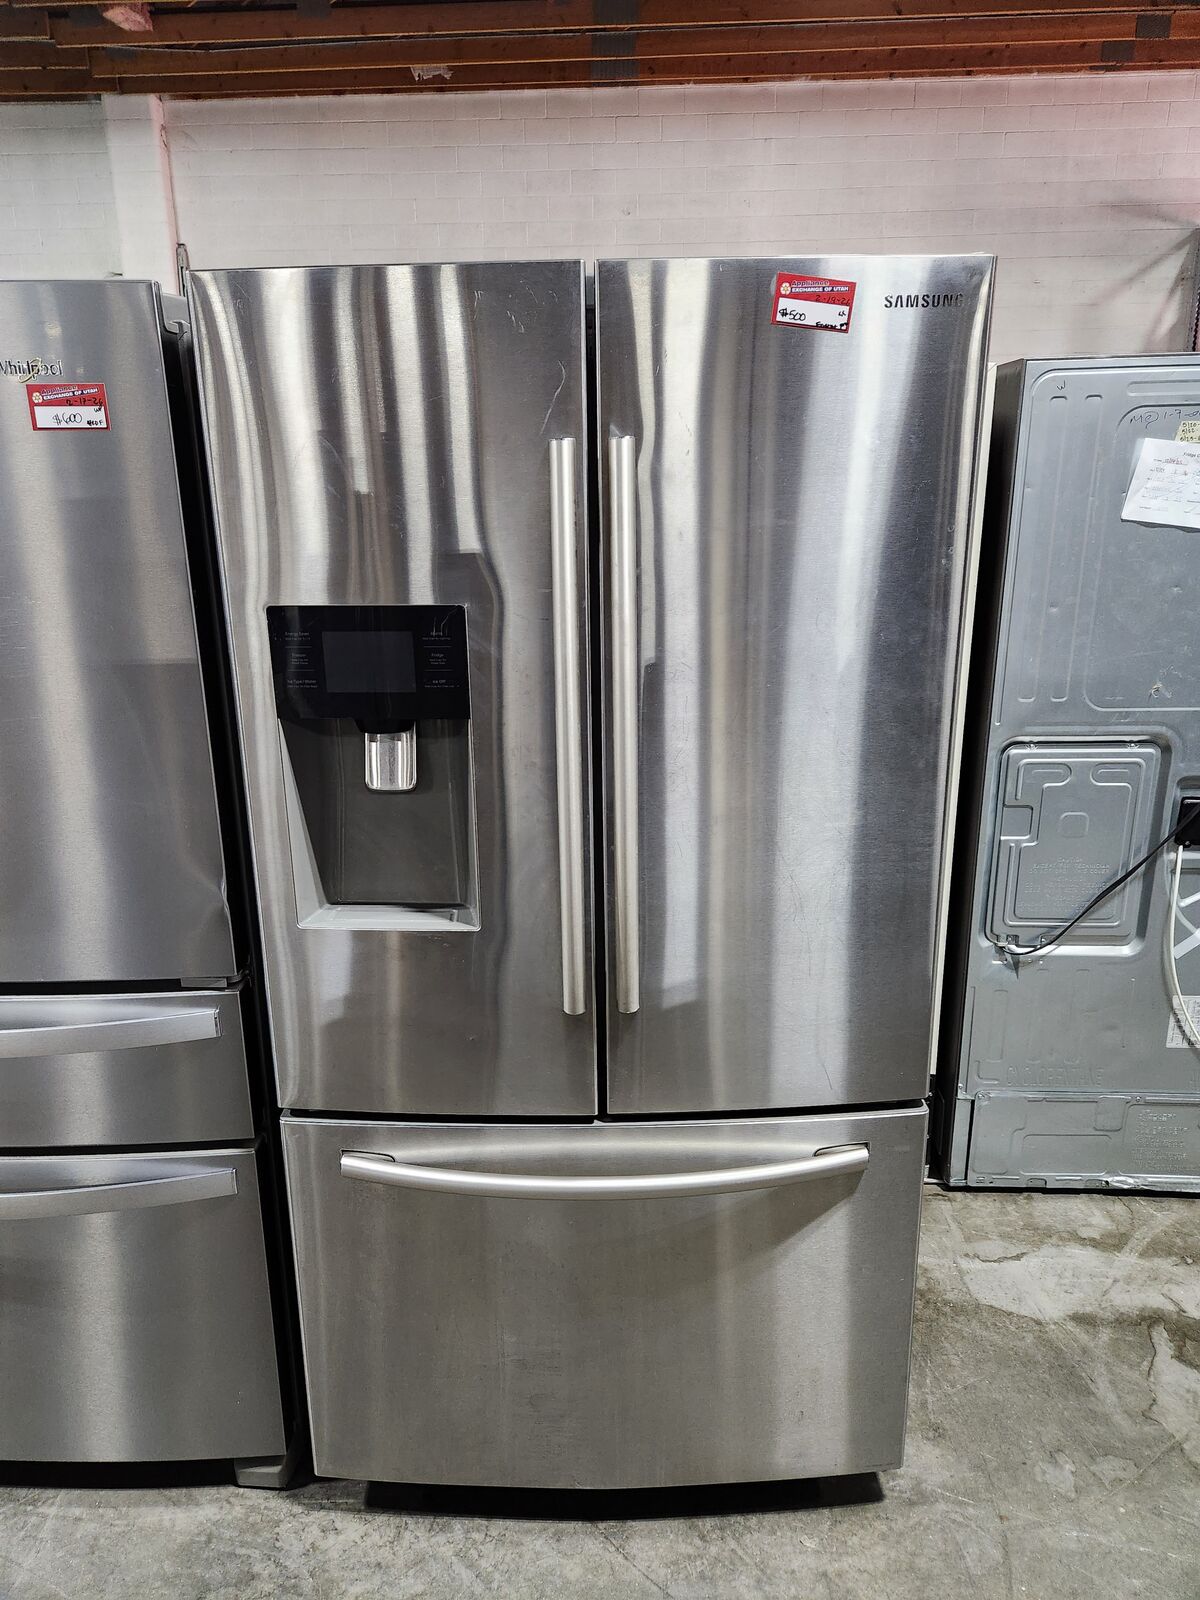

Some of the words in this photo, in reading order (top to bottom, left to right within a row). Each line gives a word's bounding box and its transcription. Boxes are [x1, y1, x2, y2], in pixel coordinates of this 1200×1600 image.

[884, 293, 964, 309] SAMSUNG
[41, 385, 79, 395] Appliance
[43, 391, 74, 401] EXCHANGE
[83, 387, 99, 395] UTAH
[52, 412, 83, 426] $600
